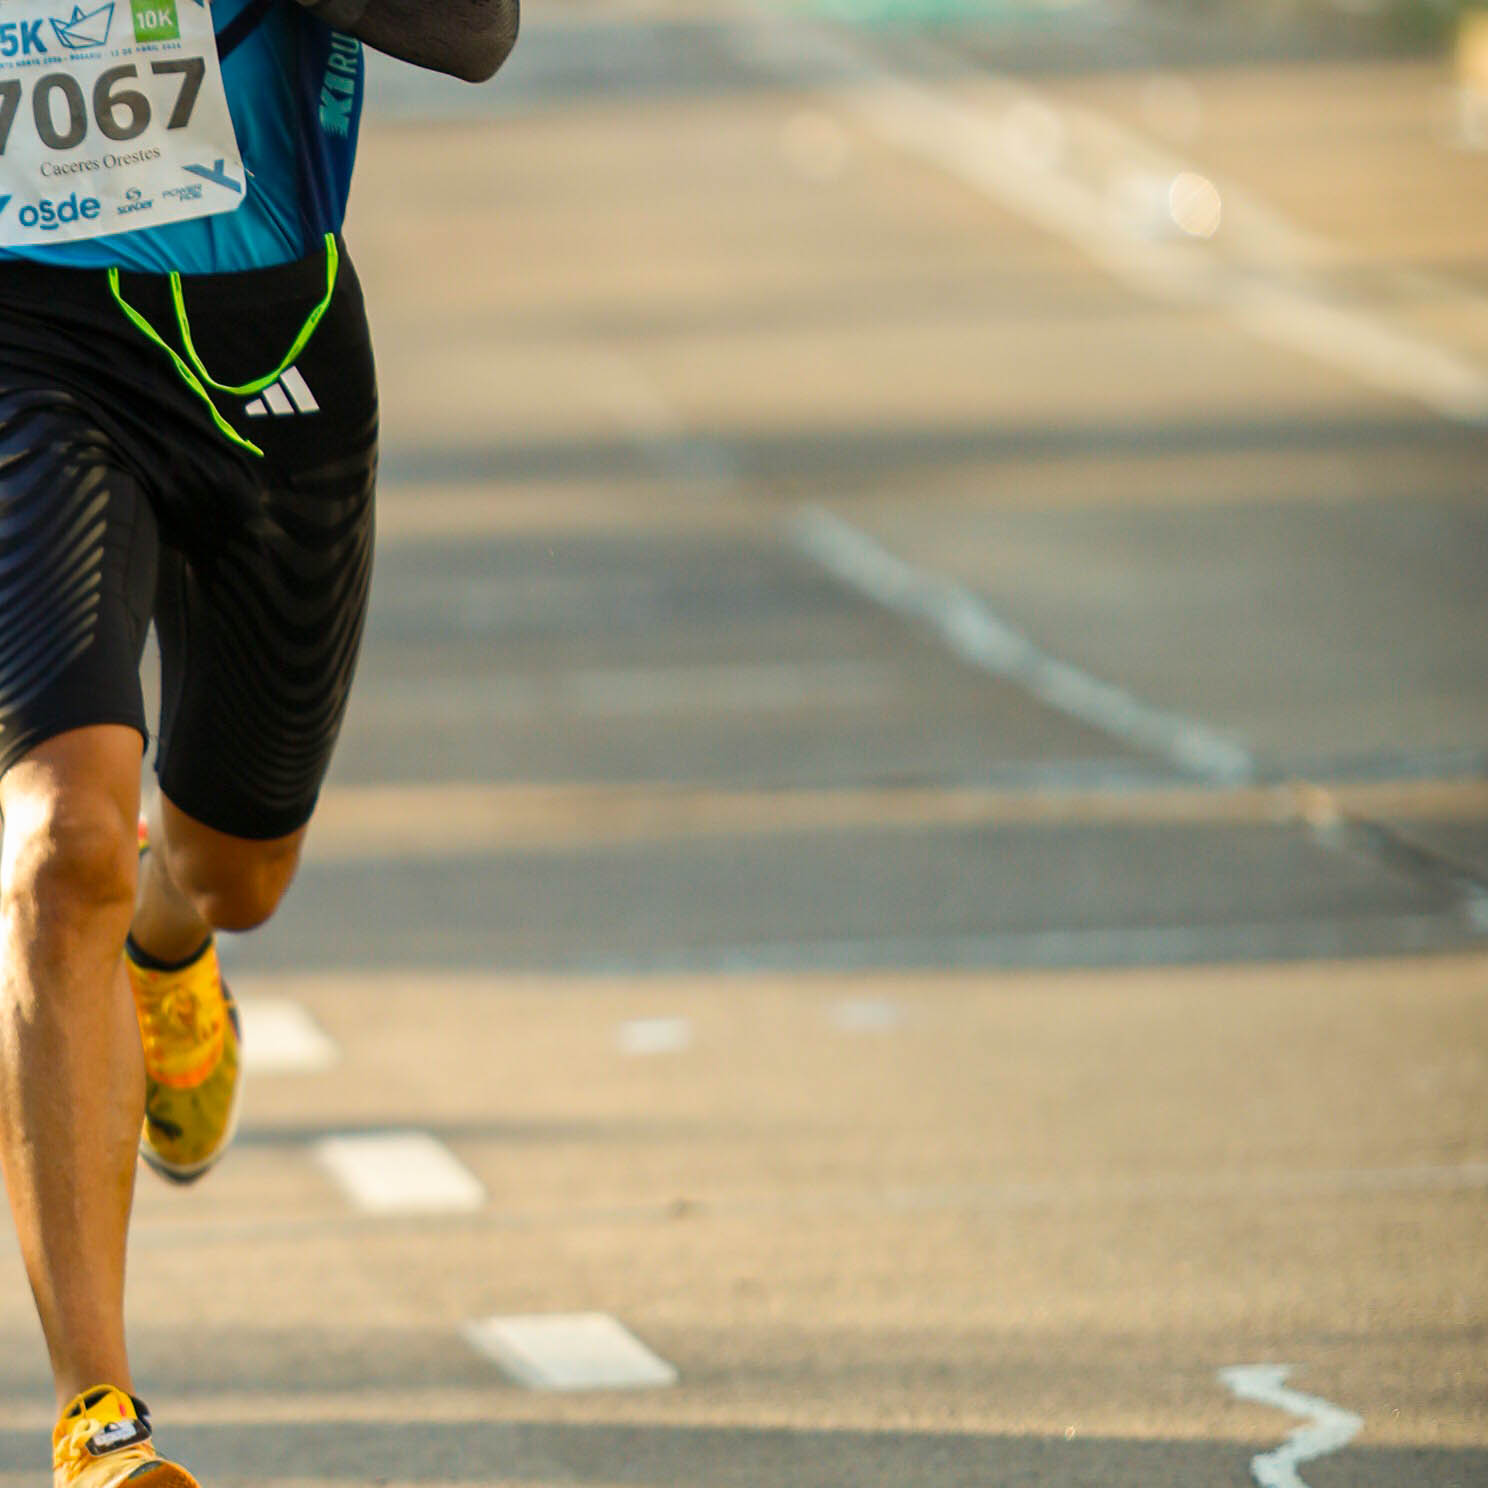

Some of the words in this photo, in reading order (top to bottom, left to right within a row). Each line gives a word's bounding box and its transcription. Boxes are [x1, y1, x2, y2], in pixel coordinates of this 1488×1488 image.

[136, 9, 173, 30] 10K
[40, 158, 100, 178] Caceres
[102, 148, 161, 171] Orestes
[18, 192, 101, 230] osde
